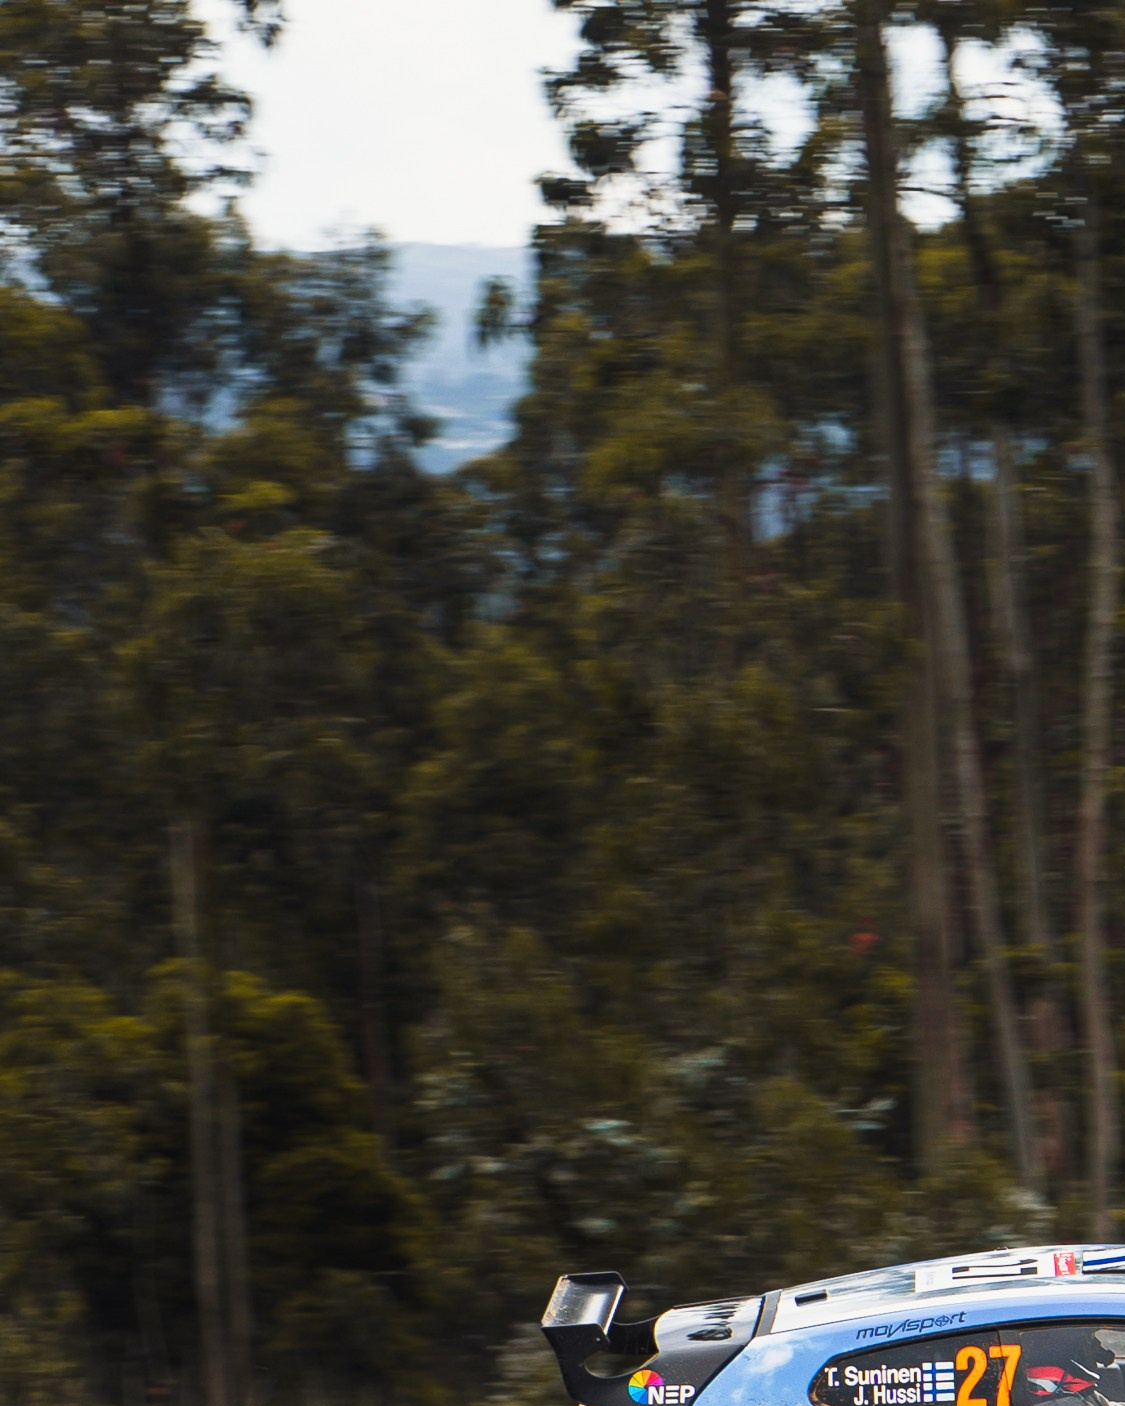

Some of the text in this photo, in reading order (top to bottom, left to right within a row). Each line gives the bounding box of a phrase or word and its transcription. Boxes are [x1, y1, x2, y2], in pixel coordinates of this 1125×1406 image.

[856, 1311, 967, 1340] movisport
[825, 1364, 921, 1387] T. Suninen
[648, 1385, 696, 1405] NEP
[853, 1383, 921, 1406] J. Hussi
